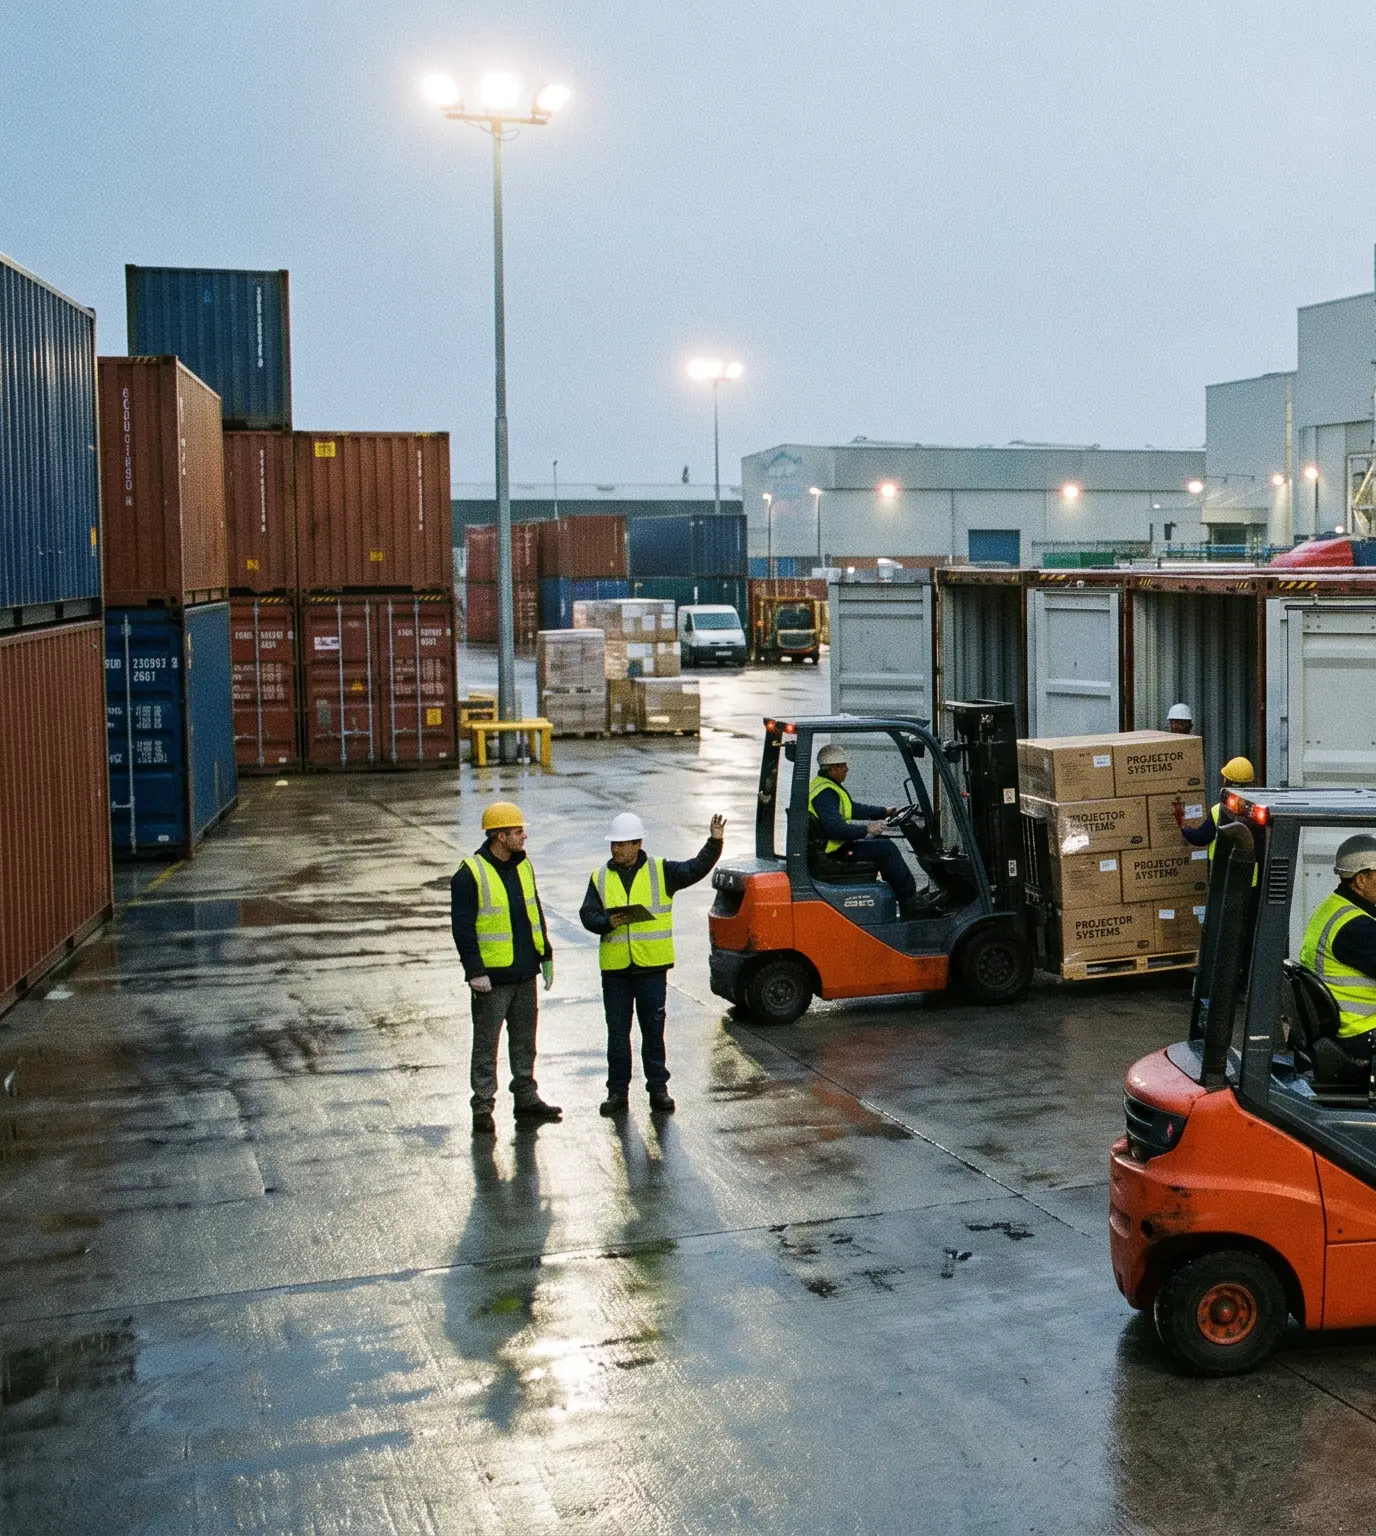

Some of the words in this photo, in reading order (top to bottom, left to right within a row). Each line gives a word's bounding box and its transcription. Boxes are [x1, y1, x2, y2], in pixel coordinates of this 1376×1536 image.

[1127, 762, 1173, 775] SYSTEMS
[1075, 915, 1133, 930] PROJECTOR
[1076, 927, 1121, 940] SYSTEMS
